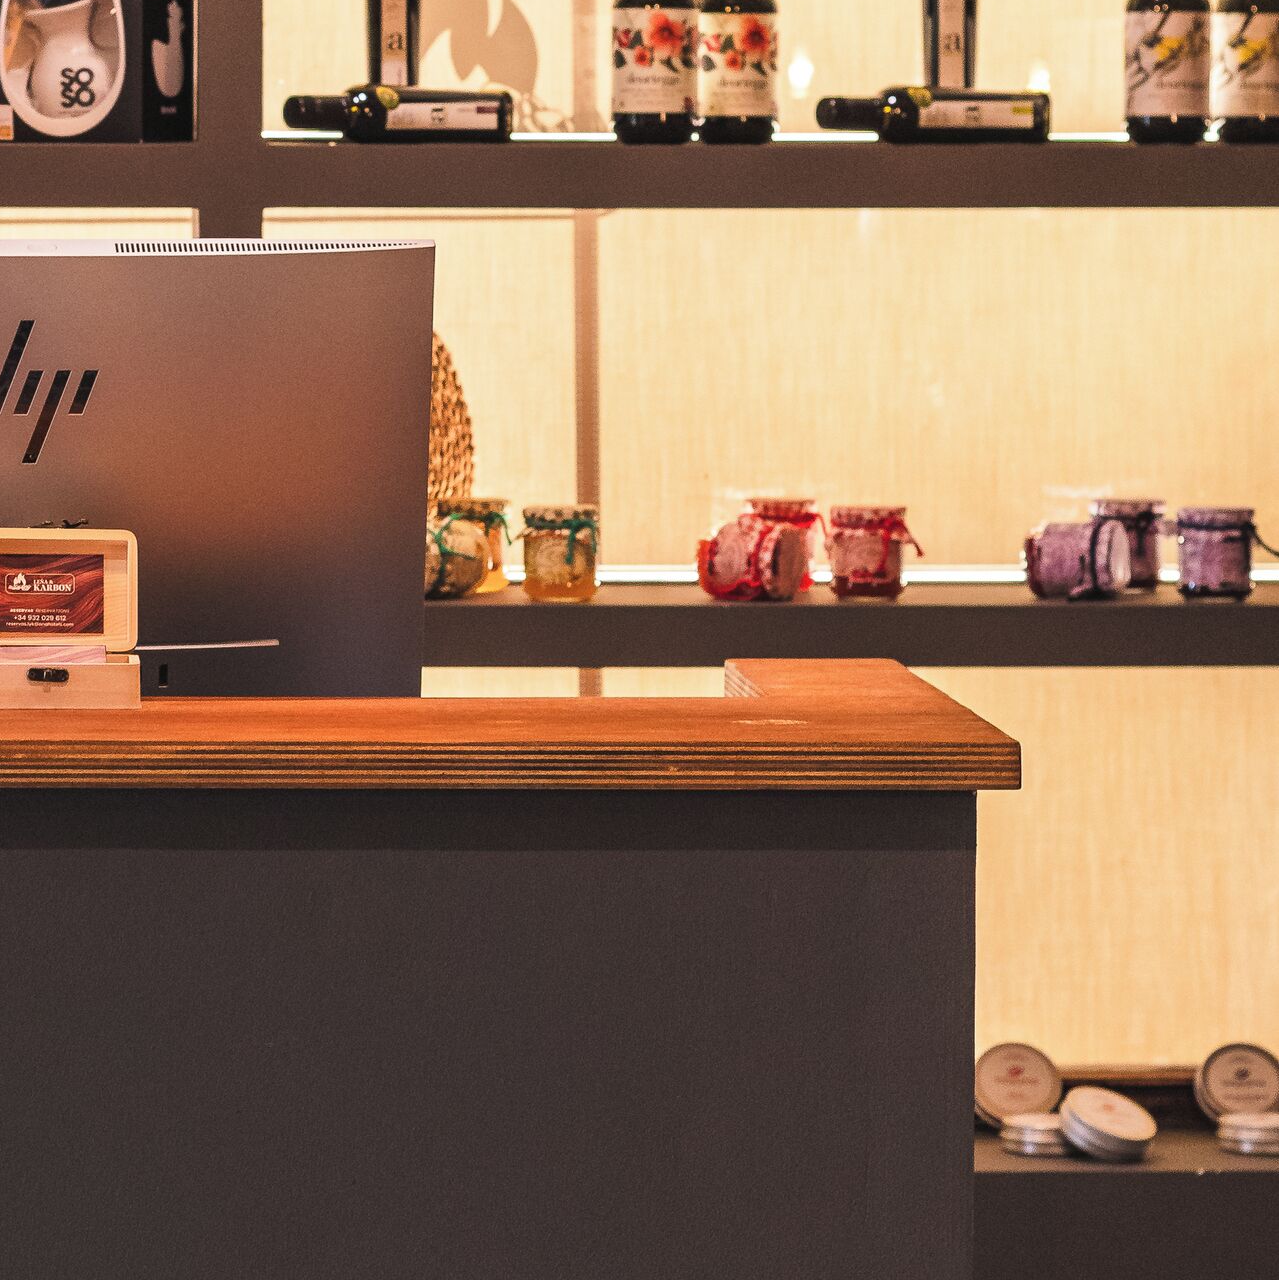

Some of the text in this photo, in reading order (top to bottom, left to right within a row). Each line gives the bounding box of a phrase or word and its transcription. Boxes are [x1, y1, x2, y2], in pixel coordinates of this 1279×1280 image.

[60, 67, 94, 87] SO
[60, 86, 96, 108] SO
[33, 584, 72, 592] KARBON
